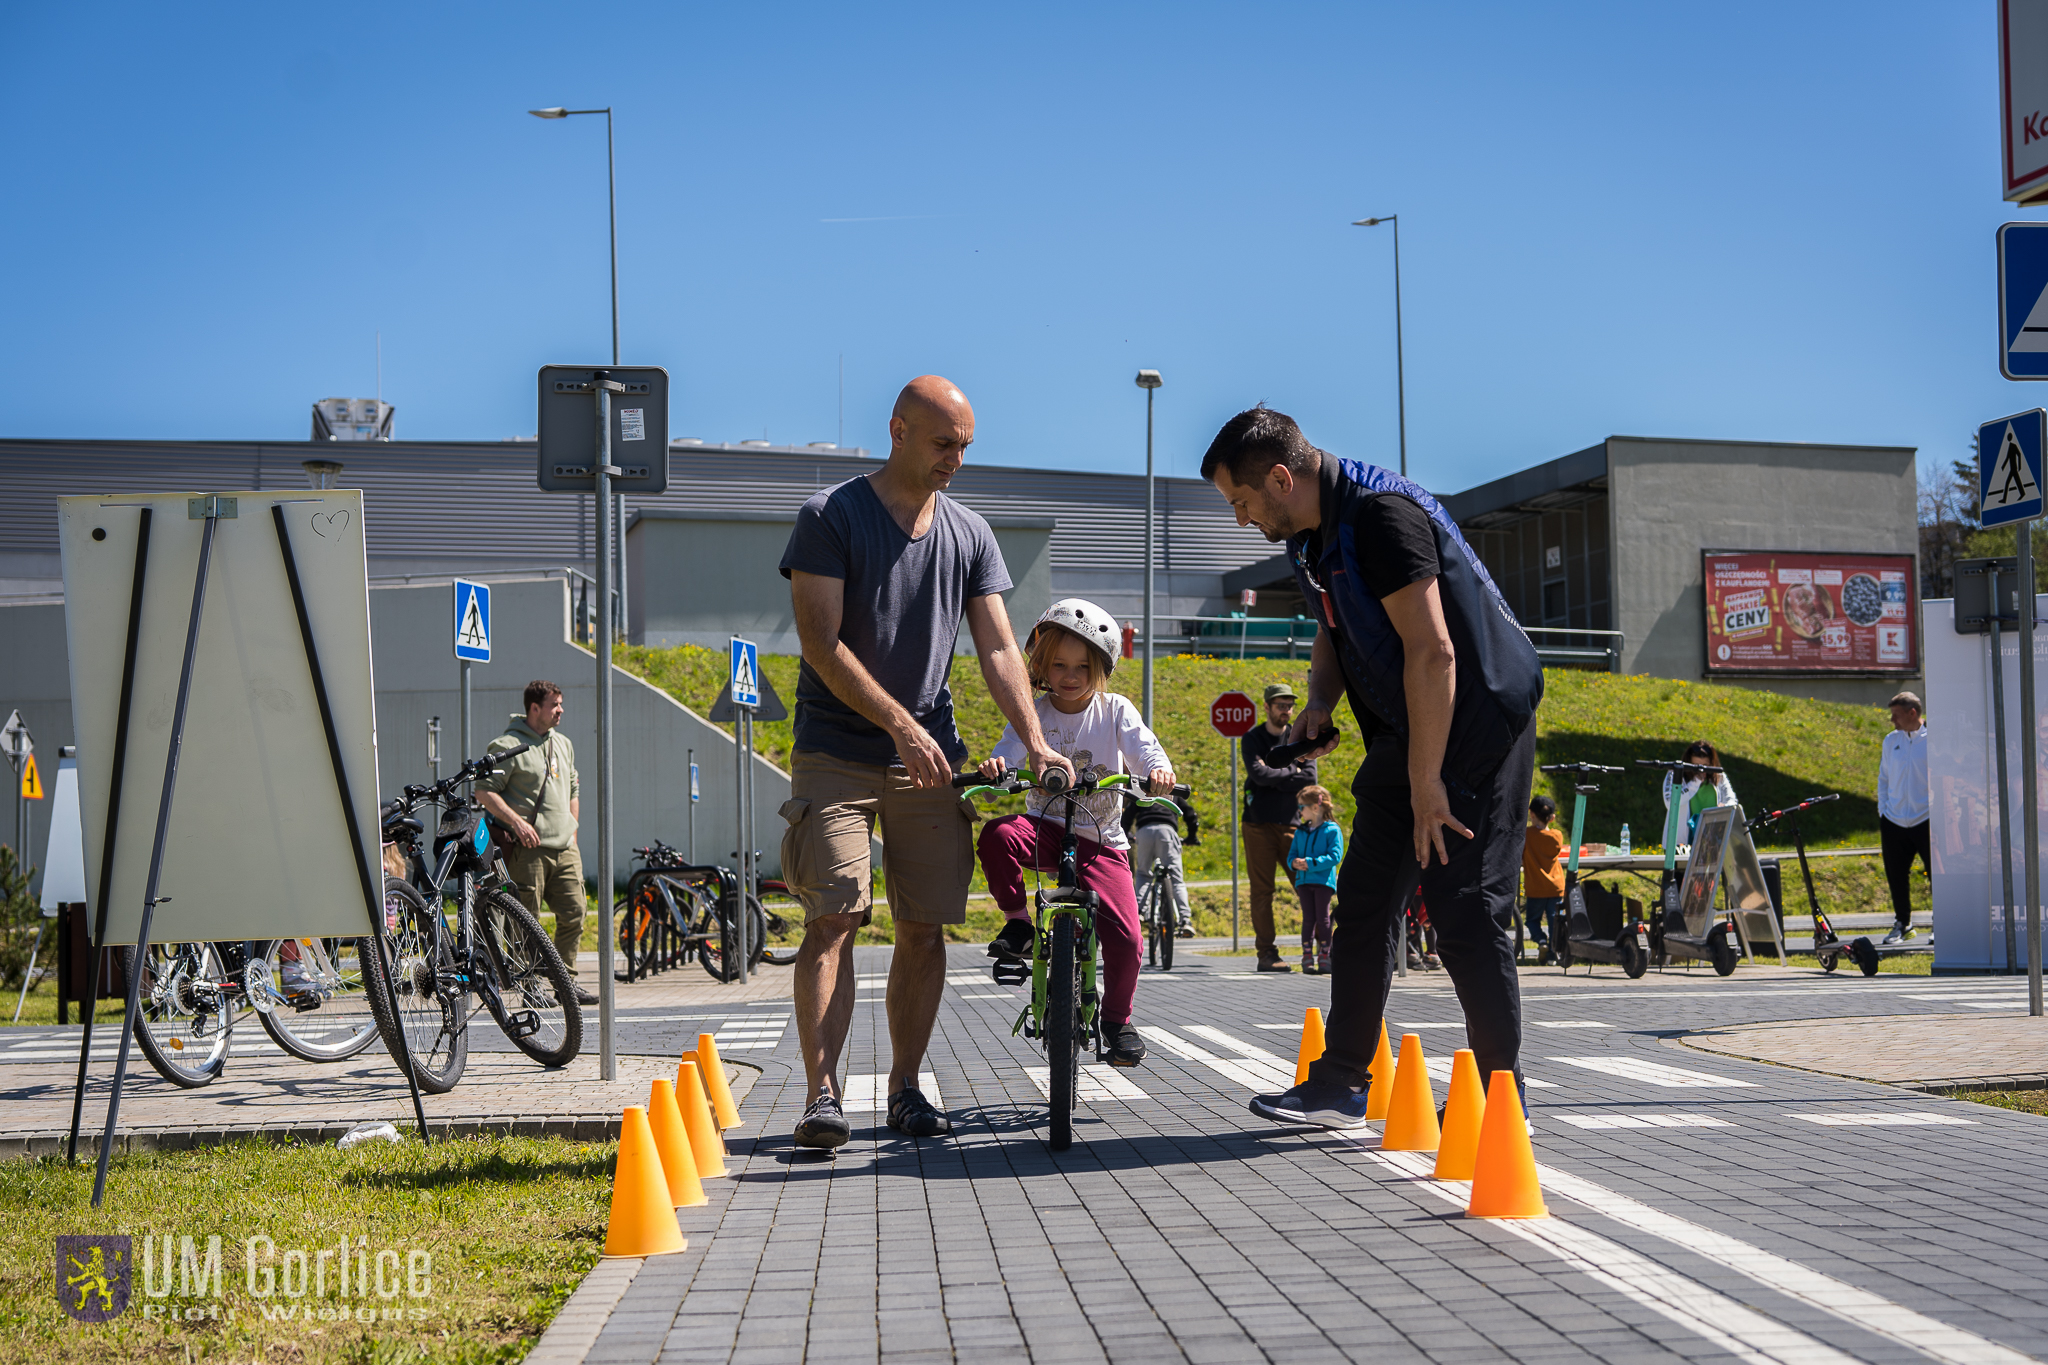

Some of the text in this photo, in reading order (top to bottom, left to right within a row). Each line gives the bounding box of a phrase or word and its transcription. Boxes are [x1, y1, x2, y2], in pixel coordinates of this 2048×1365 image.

[1715, 579, 1720, 587] Z
[1729, 599, 1759, 613] NISKIE
[1726, 608, 1766, 629] CENY
[1821, 632, 1850, 646] 15,99
[1215, 707, 1253, 723] STOP
